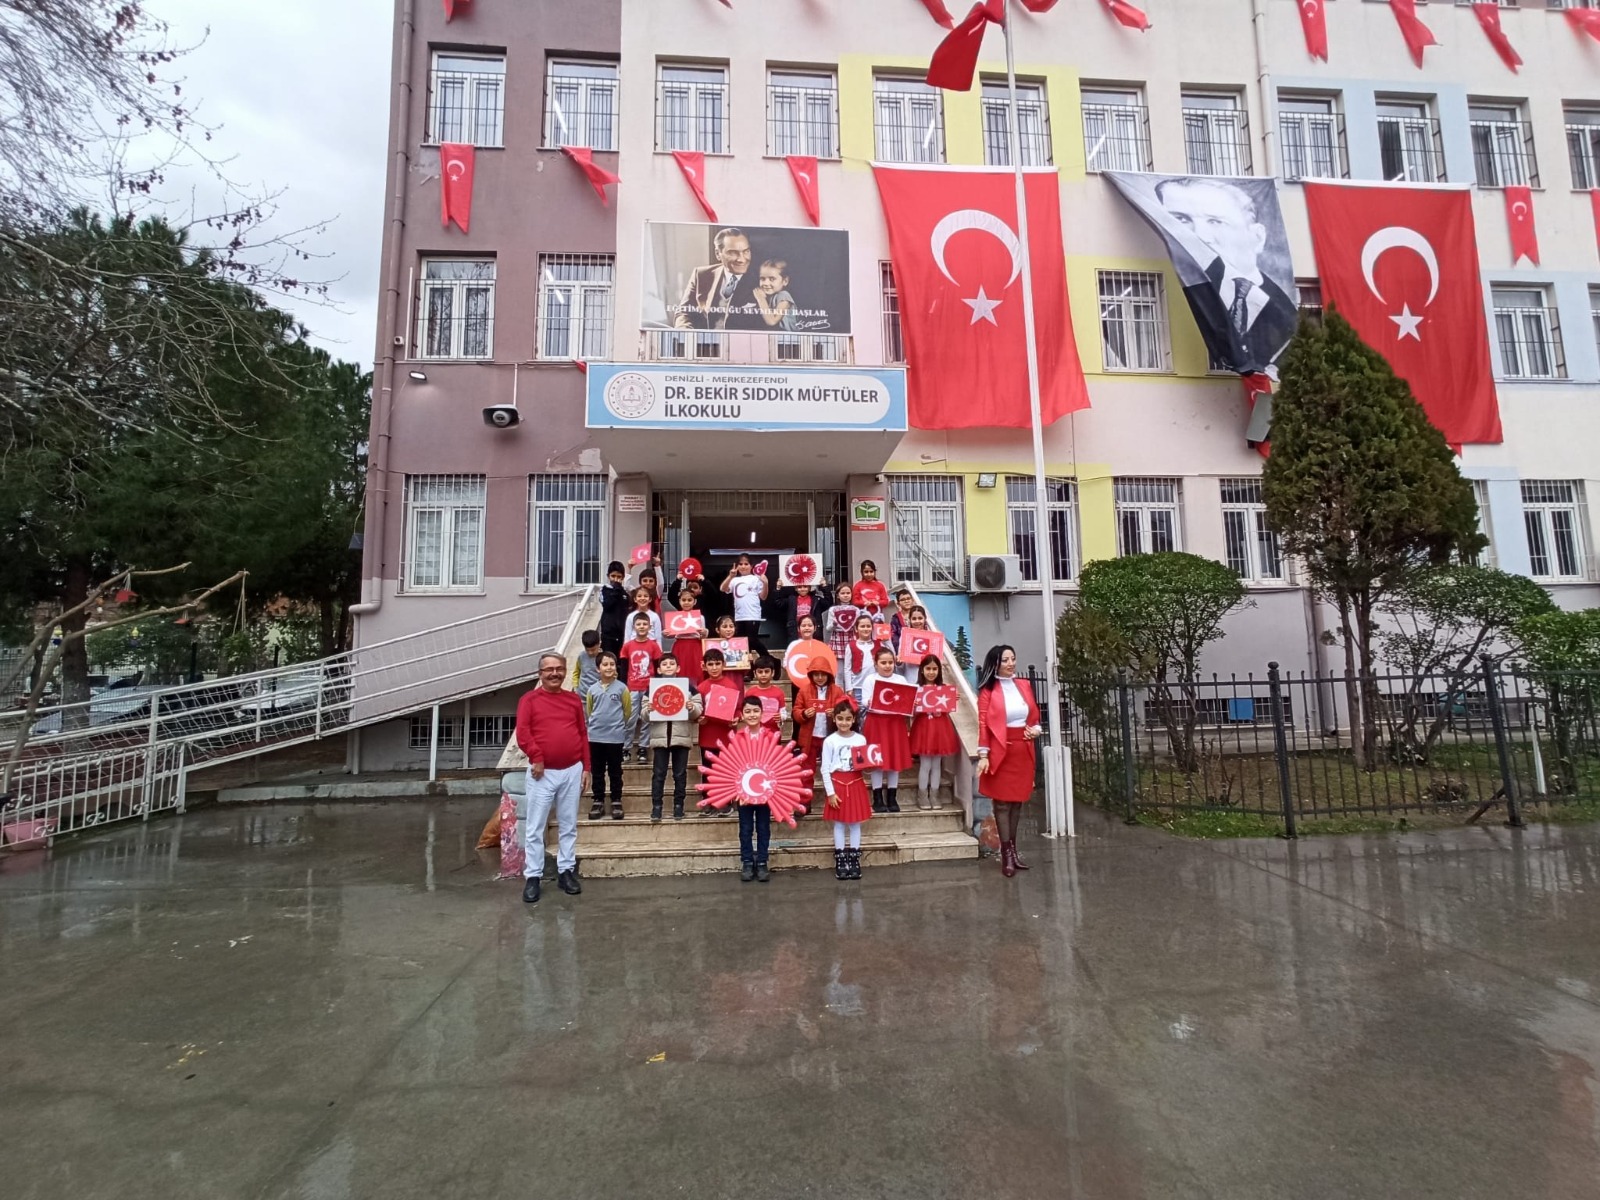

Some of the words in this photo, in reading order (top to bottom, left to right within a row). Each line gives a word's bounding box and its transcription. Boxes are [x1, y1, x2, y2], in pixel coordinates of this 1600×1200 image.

[704, 304, 742, 314] OCUĞU
[792, 309, 829, 318] BAŞLAR.
[664, 374, 704, 383] DENİZLİ
[712, 376, 788, 384] MERKEZEFENDİ
[664, 386, 691, 400] DR.
[694, 384, 739, 401] BEKİR
[742, 387, 795, 402] SIDDIK
[797, 385, 879, 403] MÜFTÜLER
[664, 401, 741, 418] İLKOKULU
